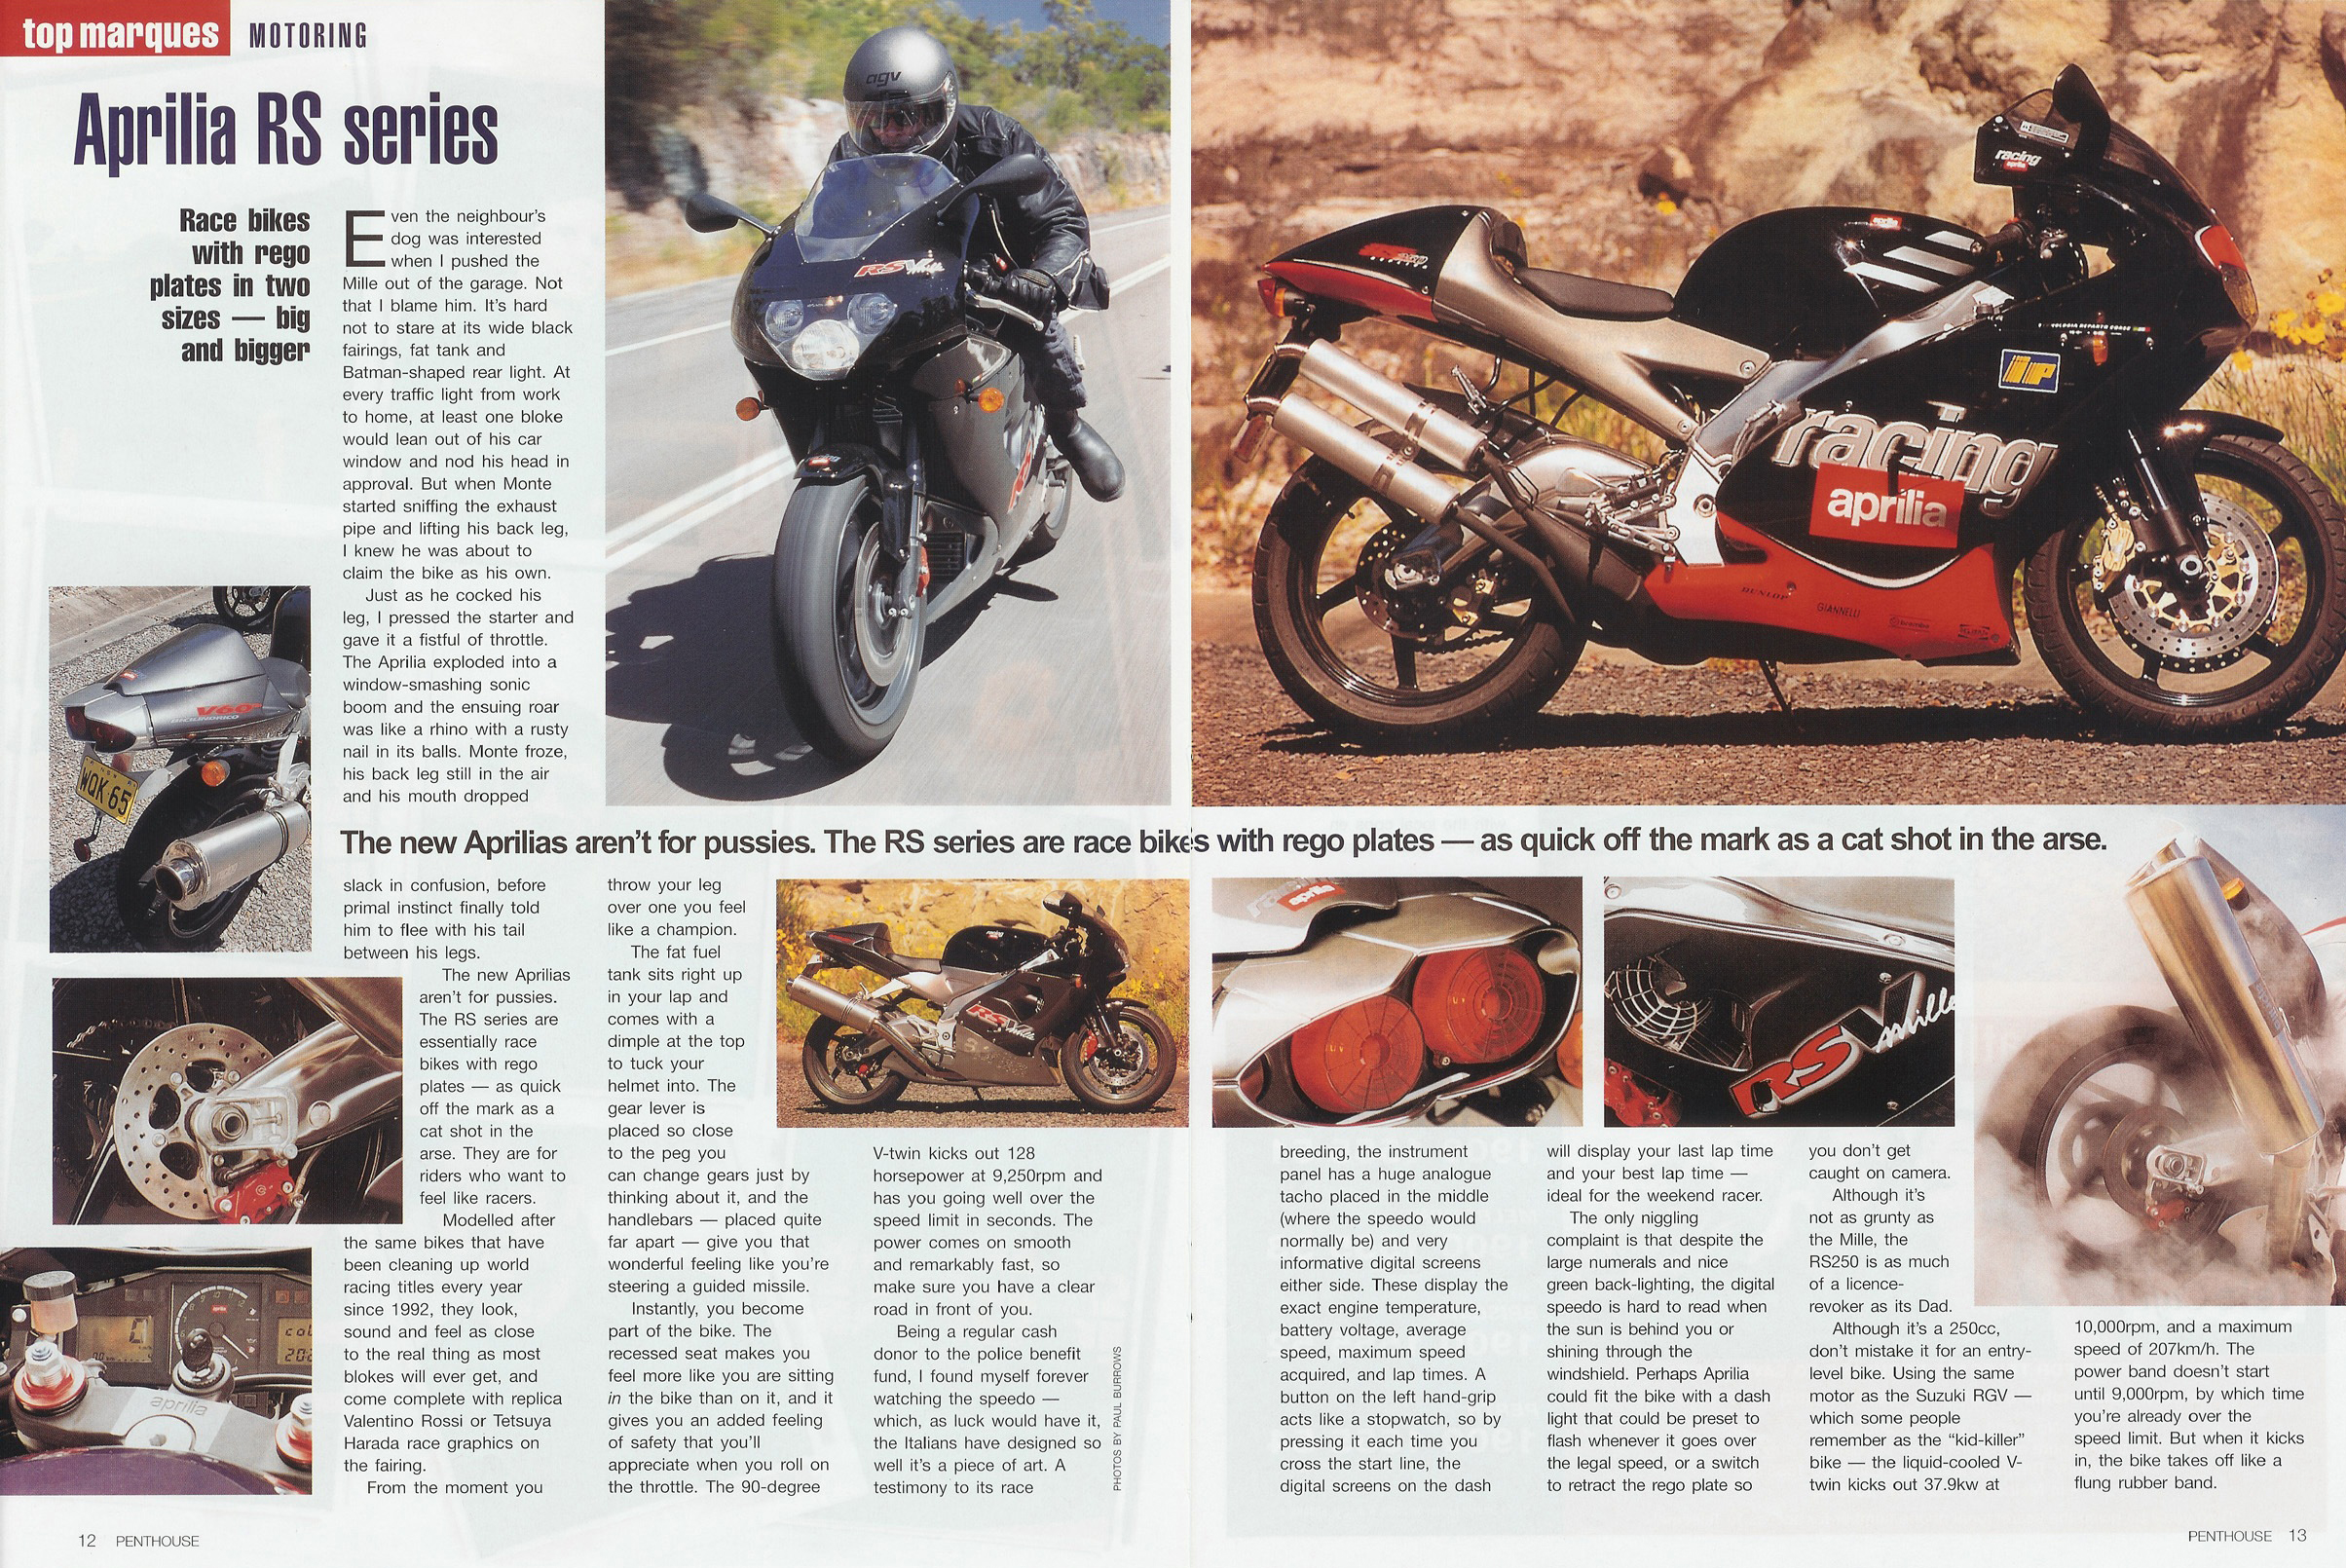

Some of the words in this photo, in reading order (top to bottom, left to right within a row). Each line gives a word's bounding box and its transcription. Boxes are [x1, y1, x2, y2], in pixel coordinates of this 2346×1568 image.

[23, 18, 72, 55] top
[80, 21, 219, 55] marques
[250, 22, 365, 48] MOTORING
[866, 71, 902, 87] agv
[74, 93, 236, 177] Aprilia
[258, 91, 320, 166] RS
[345, 92, 498, 165] series
[1994, 149, 2042, 167] racing
[180, 208, 237, 232] Race
[249, 208, 310, 232] bikes
[192, 241, 242, 264] with
[255, 245, 310, 268] rego
[151, 274, 221, 301] plates
[234, 274, 253, 296] in
[266, 275, 310, 296] two
[344, 277, 377, 289] Mille
[386, 278, 409, 289] out
[418, 277, 431, 289] of
[439, 277, 463, 289] the
[470, 280, 526, 292] garage.
[537, 277, 562, 289] Not
[163, 306, 220, 329] sizes
[277, 306, 310, 333] big
[182, 338, 222, 361] and
[235, 338, 310, 365] bigger
[1772, 404, 2059, 517] racing
[1827, 487, 1948, 531] aprilia
[1741, 586, 1789, 601] DUNLOP
[1817, 602, 1861, 618] GIANNELLI
[344, 678, 481, 693] window-smashing
[491, 678, 530, 691] sonic
[340, 831, 391, 854] The
[401, 837, 457, 854] new
[464, 830, 567, 860] Aprilias
[576, 830, 652, 853] aren't
[658, 830, 696, 853] for
[705, 830, 815, 859] pussies.
[824, 830, 875, 853] The
[885, 830, 924, 853] RS
[934, 830, 1015, 853] series
[1024, 836, 1064, 853] are
[1074, 836, 1131, 853] race
[1140, 828, 1210, 853] bikes
[1217, 828, 1273, 852] with
[1284, 834, 1344, 858] rego
[1354, 828, 1434, 857] plates
[1481, 834, 1512, 851] as
[1521, 827, 1595, 857] quick
[1604, 827, 1641, 850] off
[1650, 827, 1693, 850] the
[1701, 827, 1769, 850] mark
[1778, 833, 1809, 850] as
[1818, 833, 1833, 850] a
[1843, 828, 1883, 850] cat
[1891, 827, 1952, 850] shot
[1960, 827, 1983, 850] in
[1992, 827, 2034, 850] the
[2043, 833, 2106, 850] arse.
[345, 901, 389, 917] primal
[398, 901, 452, 914] instinct
[460, 901, 503, 917] finally
[511, 901, 539, 914] told
[631, 946, 659, 958] The
[667, 946, 686, 958] fat
[693, 946, 720, 958] fuel
[420, 1035, 497, 1051] essentially
[505, 1038, 537, 1048] race
[609, 1172, 635, 1181] can
[644, 1169, 699, 1184] change
[708, 1172, 749, 1184] gears
[757, 1169, 783, 1184] just
[792, 1169, 809, 1184] by
[875, 1170, 964, 1185] horsepower
[972, 1170, 986, 1181] at
[993, 1170, 1064, 1184] 9,250rpm
[1074, 1169, 1101, 1181] and
[1281, 1256, 1362, 1269] informative
[1371, 1256, 1414, 1272] digital
[1423, 1259, 1480, 1269] screens
[1547, 1256, 1582, 1272] large
[1590, 1255, 1656, 1268] numerals
[1663, 1255, 1690, 1268] and
[1698, 1255, 1728, 1268] nice
[1810, 1255, 1858, 1268] RS250
[1867, 1255, 1877, 1268] is
[1884, 1258, 1901, 1268] as
[1910, 1255, 1949, 1267] much
[345, 1303, 384, 1316] since
[392, 1303, 432, 1318] 1992,
[441, 1303, 473, 1319] they
[482, 1303, 517, 1317] look,
[1281, 1302, 1321, 1314] exact
[1329, 1301, 1378, 1317] engine
[1386, 1301, 1480, 1317] temperature,
[2075, 1321, 2159, 1335] 10,000rpm,
[2168, 1320, 2194, 1332] and
[2203, 1324, 2211, 1332] a
[2219, 1320, 2291, 1332] maximum
[1113, 1346, 1122, 1399] BURROWS
[150, 1395, 208, 1416] aprilia
[344, 1415, 413, 1427] Valentino
[423, 1414, 462, 1427] Rossi
[470, 1418, 486, 1427] or
[494, 1414, 551, 1430] Tetsuya
[1113, 1402, 1122, 1428] PAUL
[1113, 1432, 1122, 1445] BY
[1113, 1450, 1122, 1491] PHOTOS
[1809, 1478, 1840, 1490] twin
[1849, 1478, 1885, 1490] kicks
[1893, 1478, 1917, 1490] out
[1925, 1478, 1978, 1490] 37.9kw
[1986, 1478, 1999, 1490] at
[2074, 1476, 2110, 1492] flung
[2119, 1476, 2168, 1488] rubber
[2176, 1476, 2216, 1488] band.
[80, 1534, 95, 1547] 12
[117, 1536, 199, 1547] PENTHOUSE
[2189, 1531, 2271, 1542] PENTHOUSE
[2290, 1529, 2306, 1541] 13
